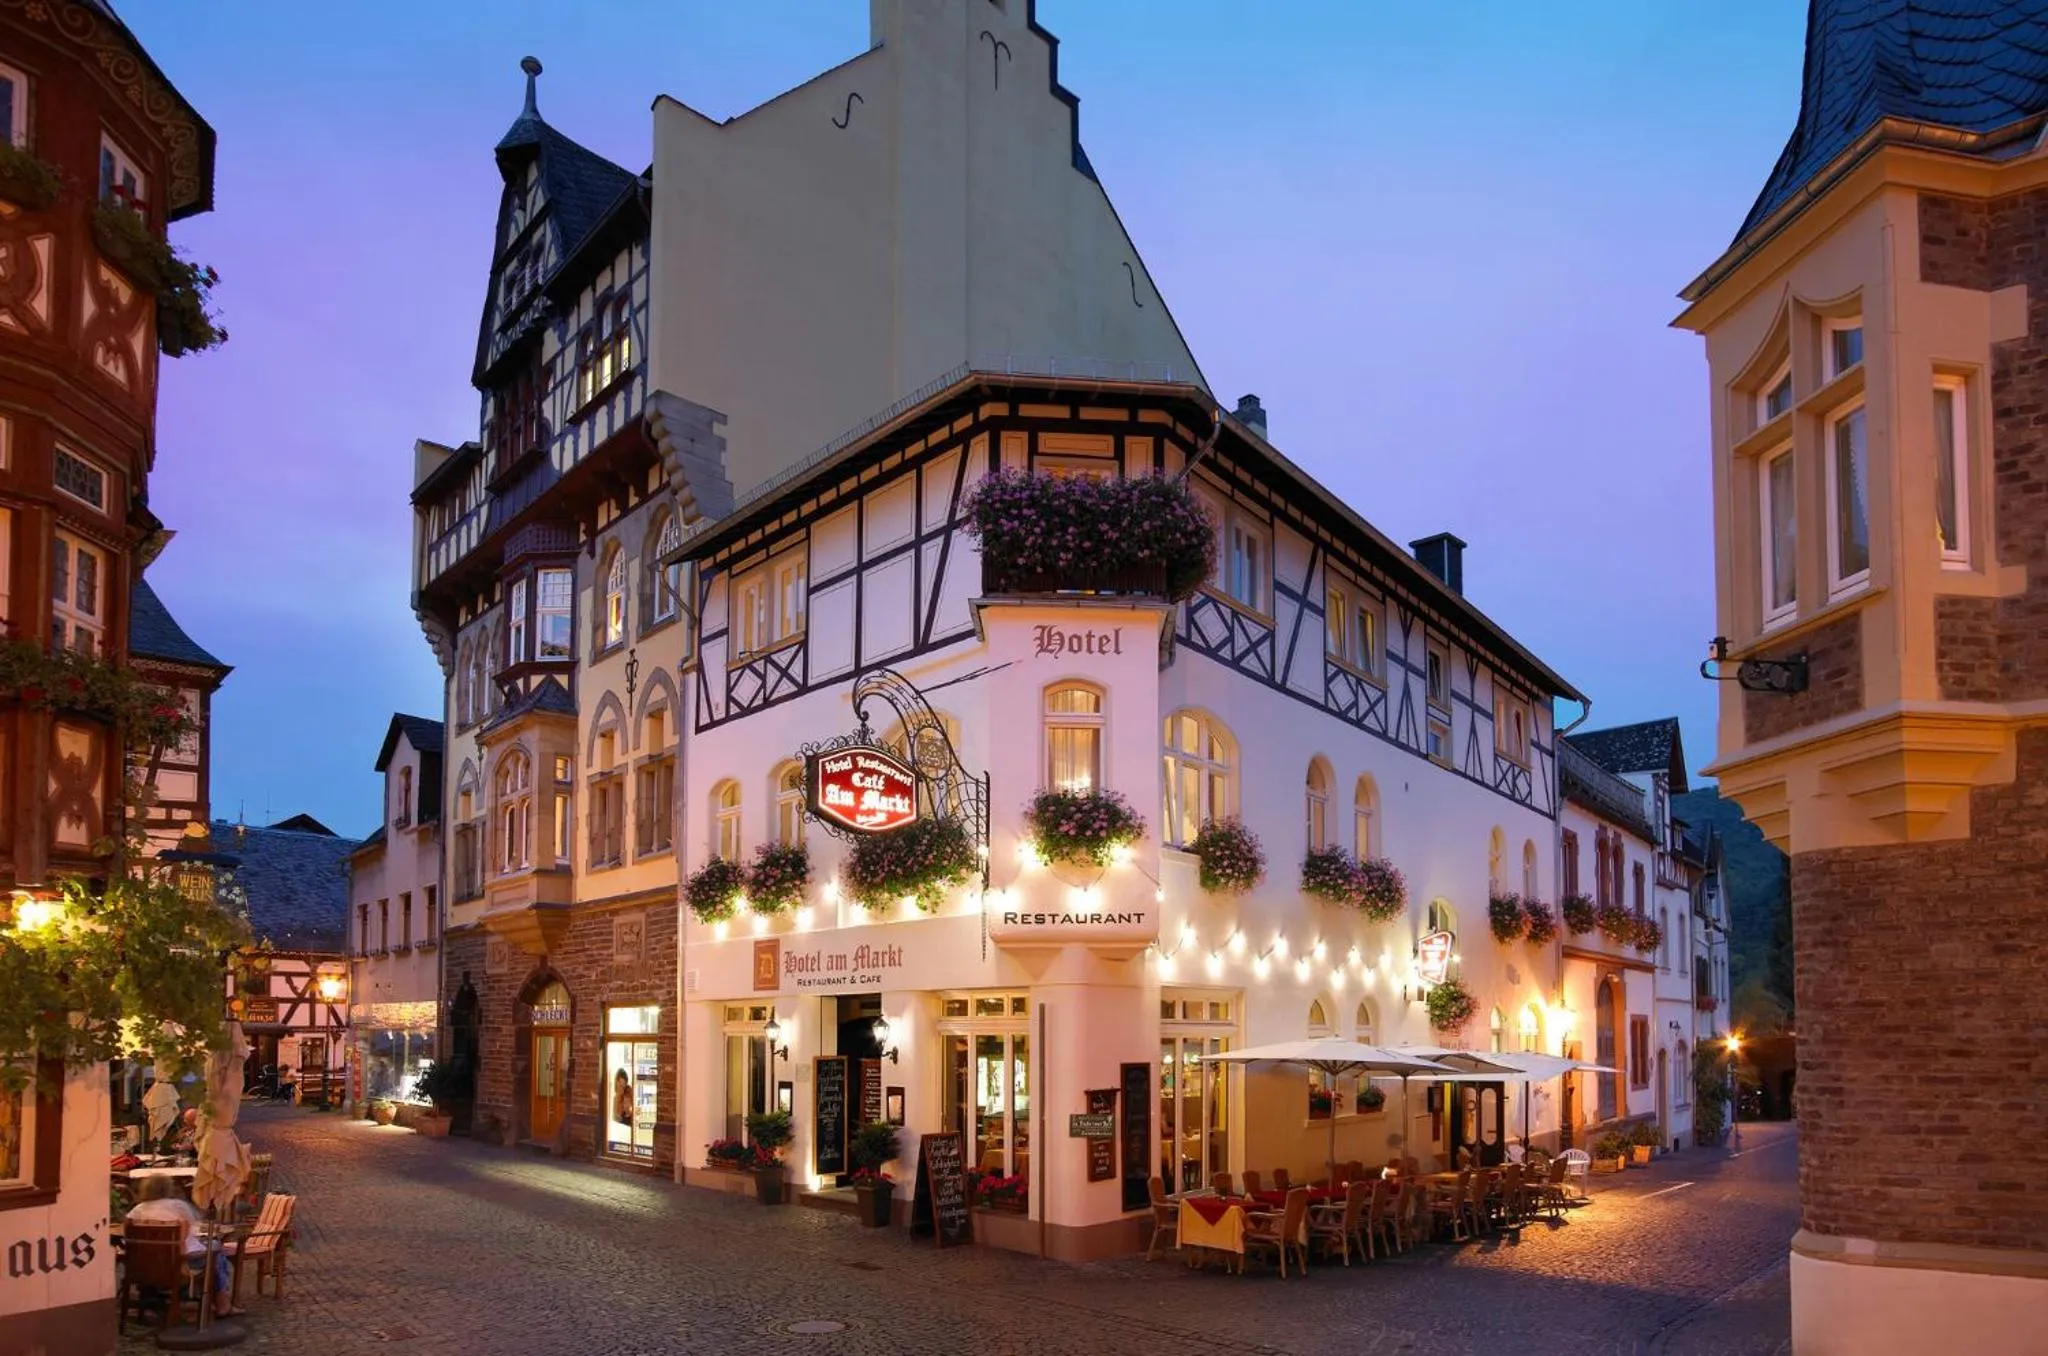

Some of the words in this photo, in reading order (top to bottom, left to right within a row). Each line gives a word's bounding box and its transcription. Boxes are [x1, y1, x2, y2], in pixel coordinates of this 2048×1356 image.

[1032, 624, 1124, 660] Hotel
[824, 756, 853, 774] Hotel
[856, 756, 913, 787] Restaurant
[851, 772, 886, 791] Café
[859, 789, 911, 814] Markt
[783, 950, 822, 977] Hotel
[826, 953, 848, 971] am
[852, 943, 904, 973] Markt
[850, 976, 857, 984] &
